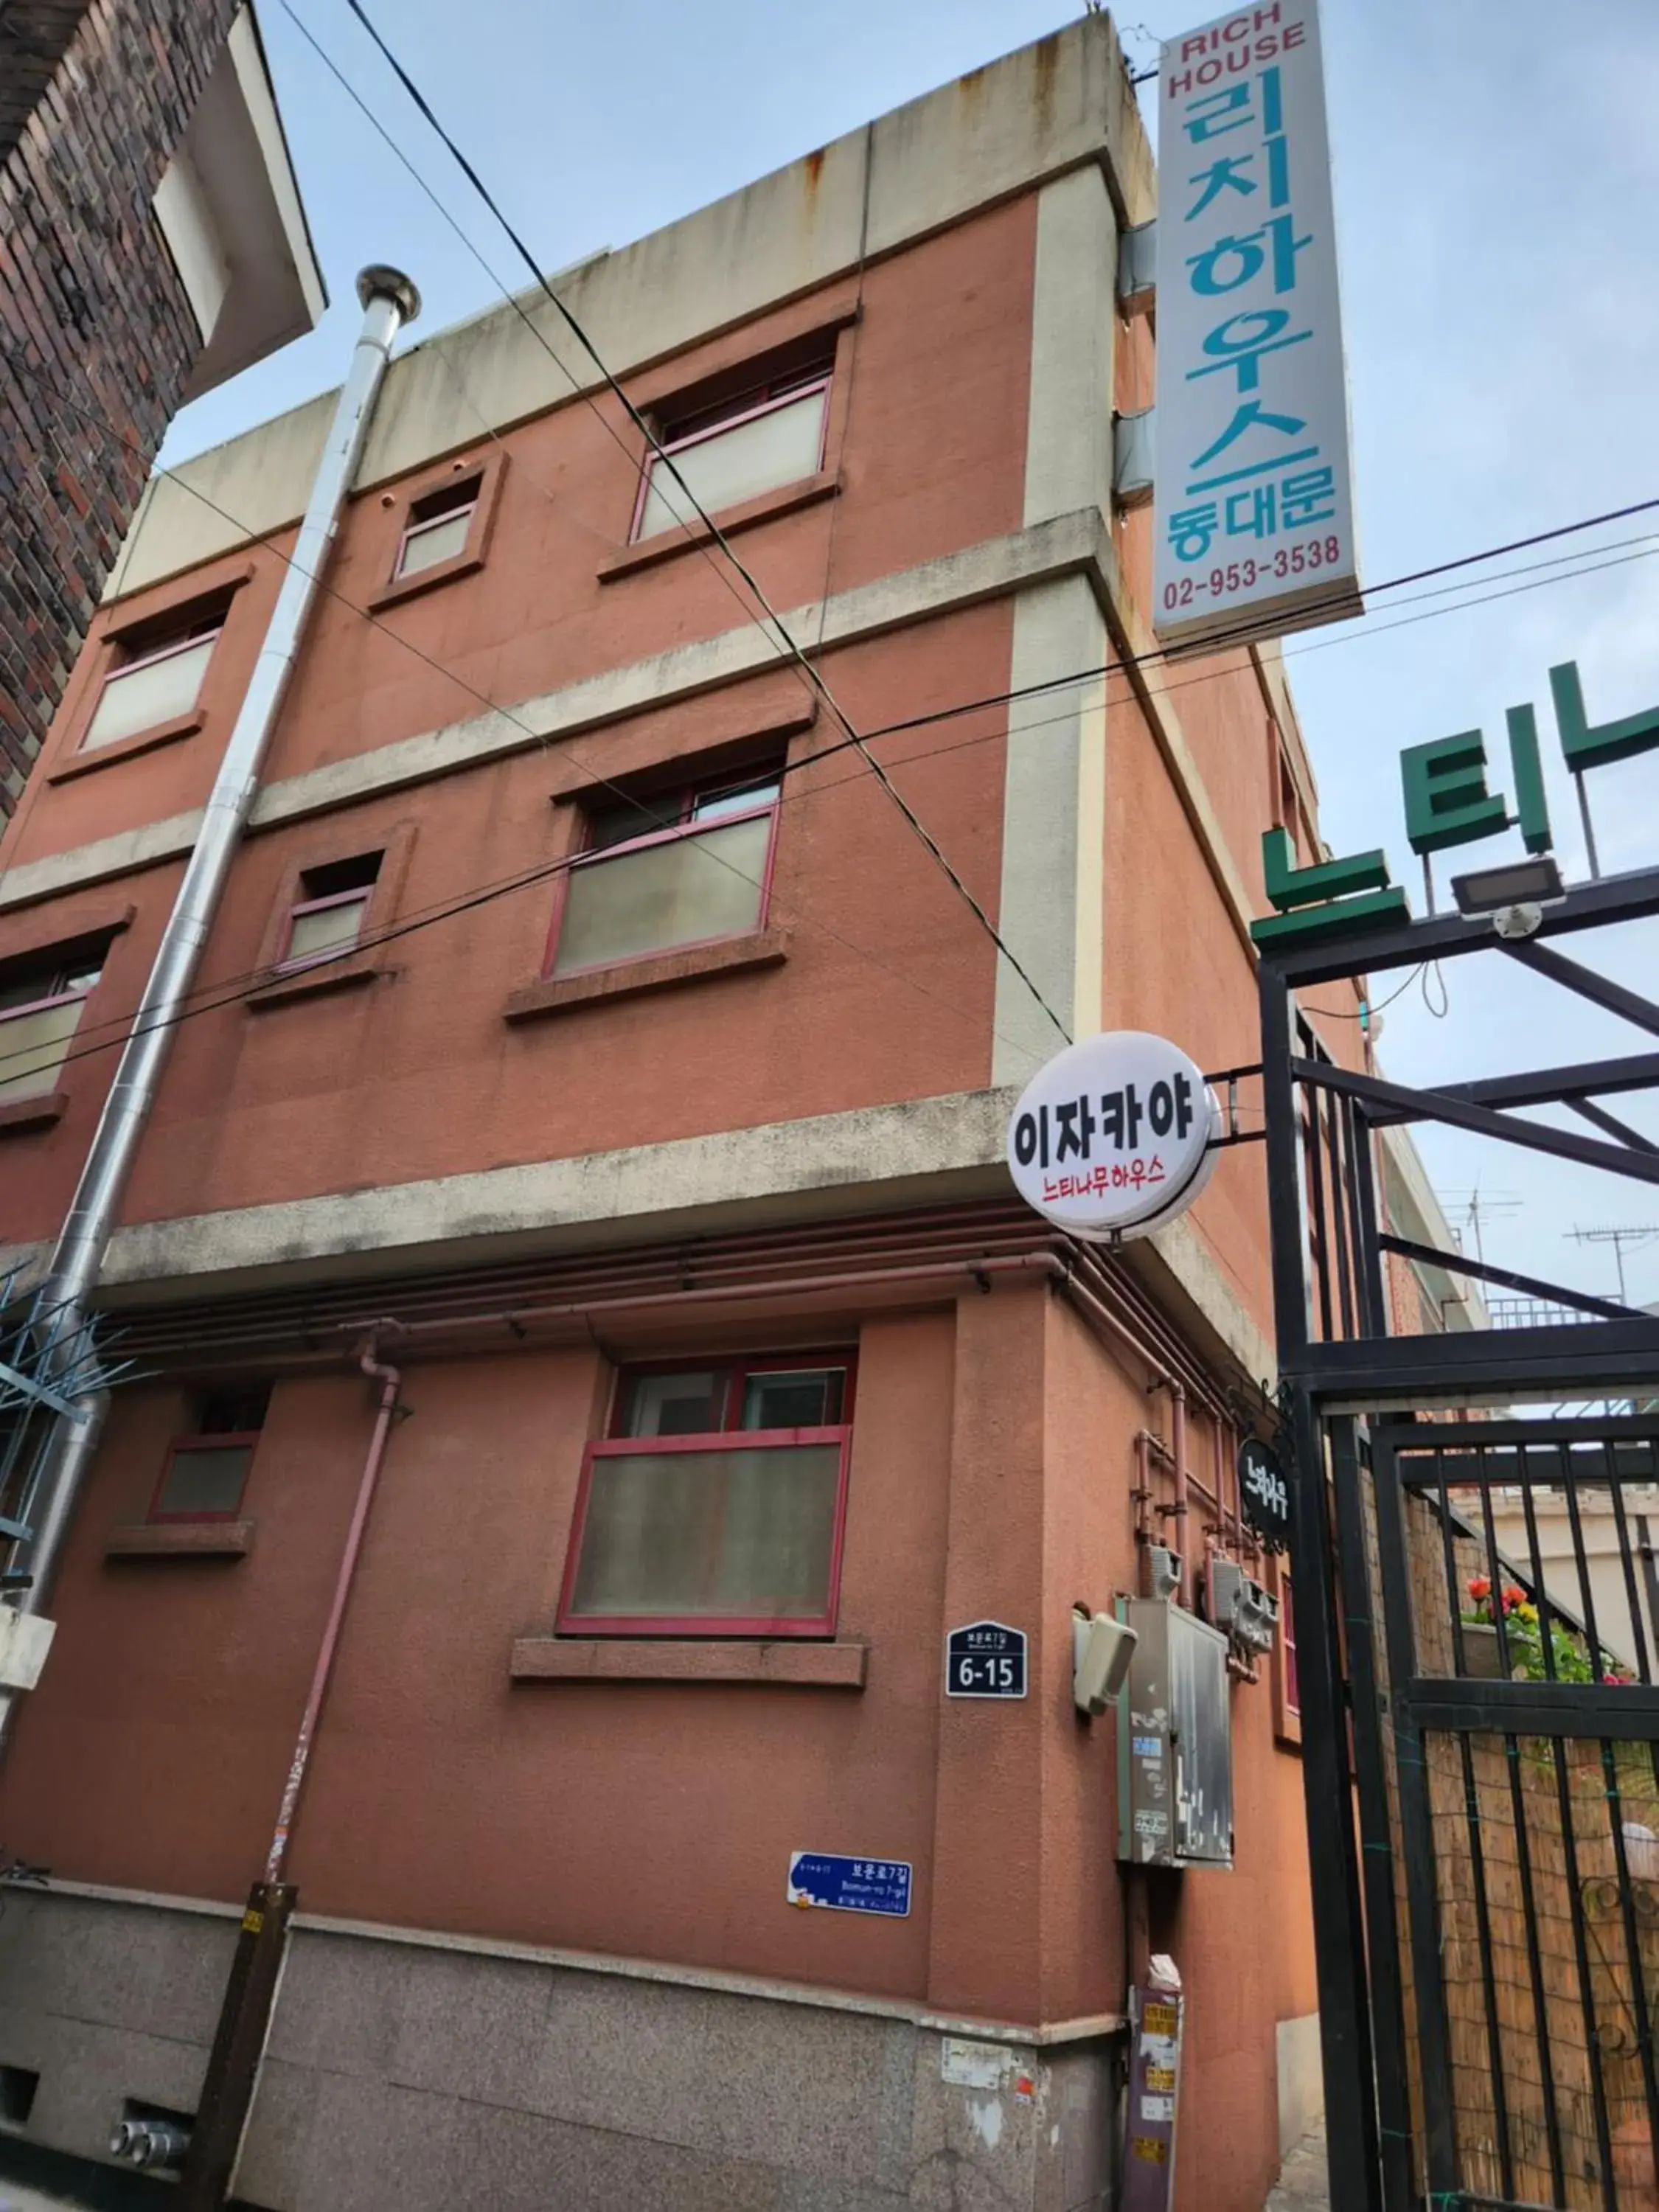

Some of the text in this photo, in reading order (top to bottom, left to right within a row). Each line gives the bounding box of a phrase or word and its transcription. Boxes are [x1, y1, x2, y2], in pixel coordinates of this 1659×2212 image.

[1168, 22, 1306, 99] HOUSE
[1181, 2, 1281, 62] RICH
[1183, 65, 1319, 496] 리치하우스
[1168, 467, 1335, 563] 동대문
[1164, 536, 1340, 610] 02-953-3538
[1015, 1071, 1193, 1168] 이자카야
[959, 1658, 1013, 1686] 6-15
